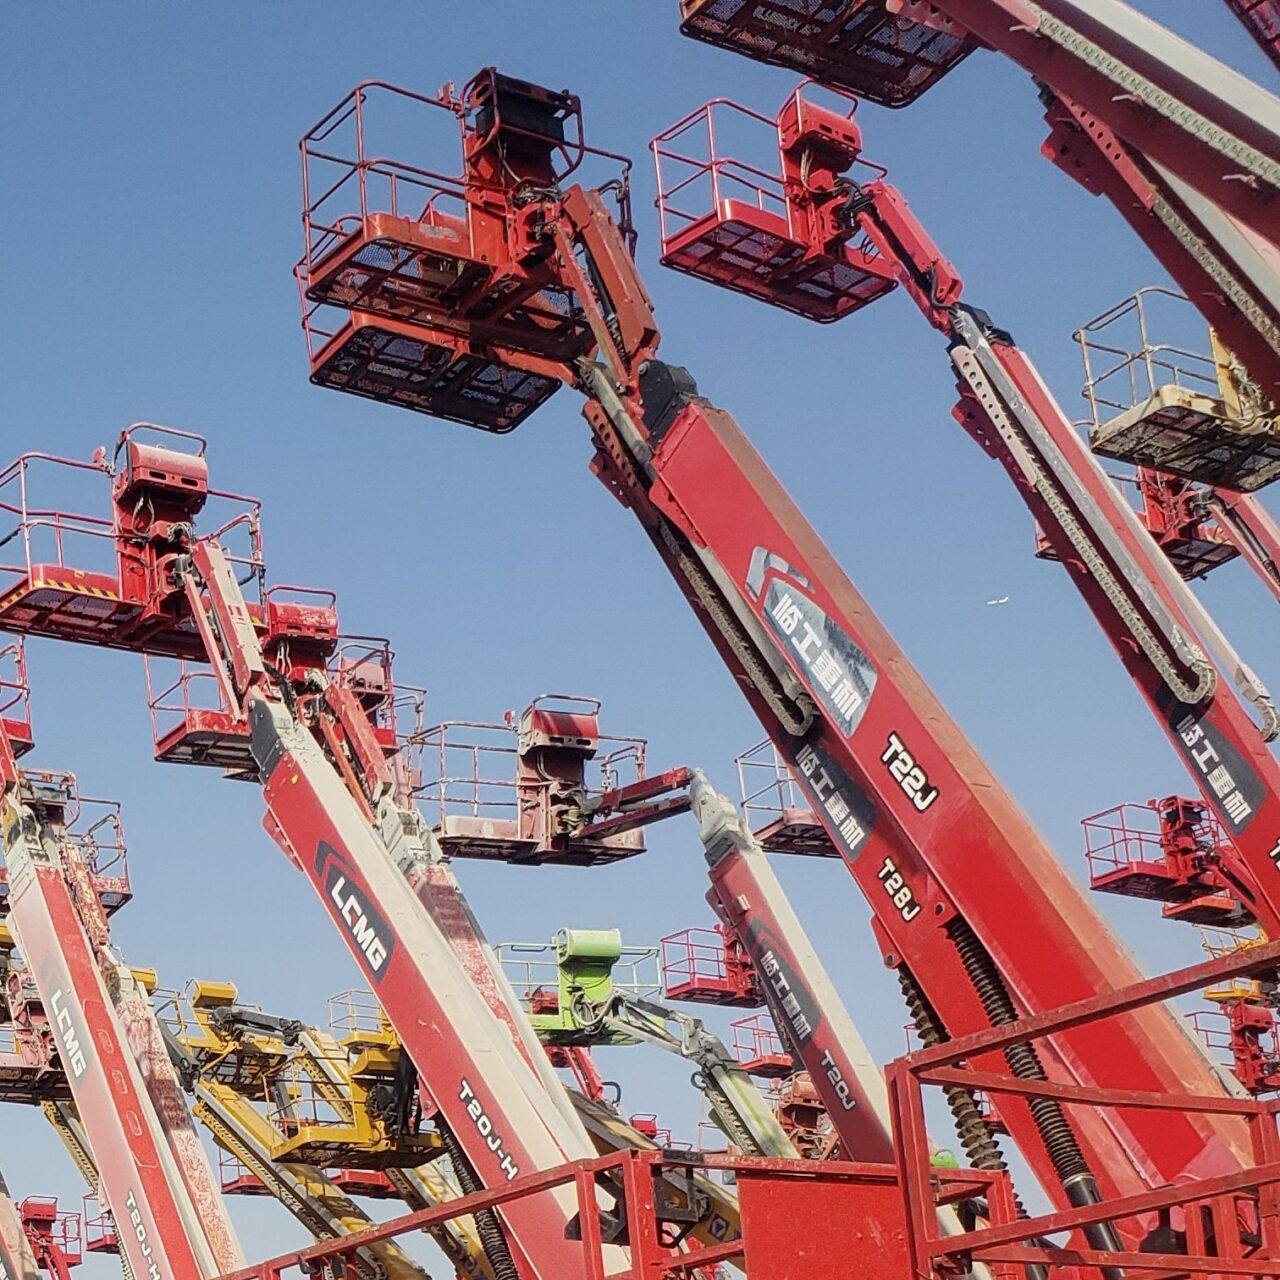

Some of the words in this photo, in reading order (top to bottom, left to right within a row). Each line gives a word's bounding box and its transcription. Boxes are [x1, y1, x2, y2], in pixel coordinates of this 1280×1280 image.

[880, 732, 939, 812] T22J
[878, 857, 922, 921] T28J
[820, 1050, 856, 1111] T20J
[458, 1079, 520, 1181] T20J-H
